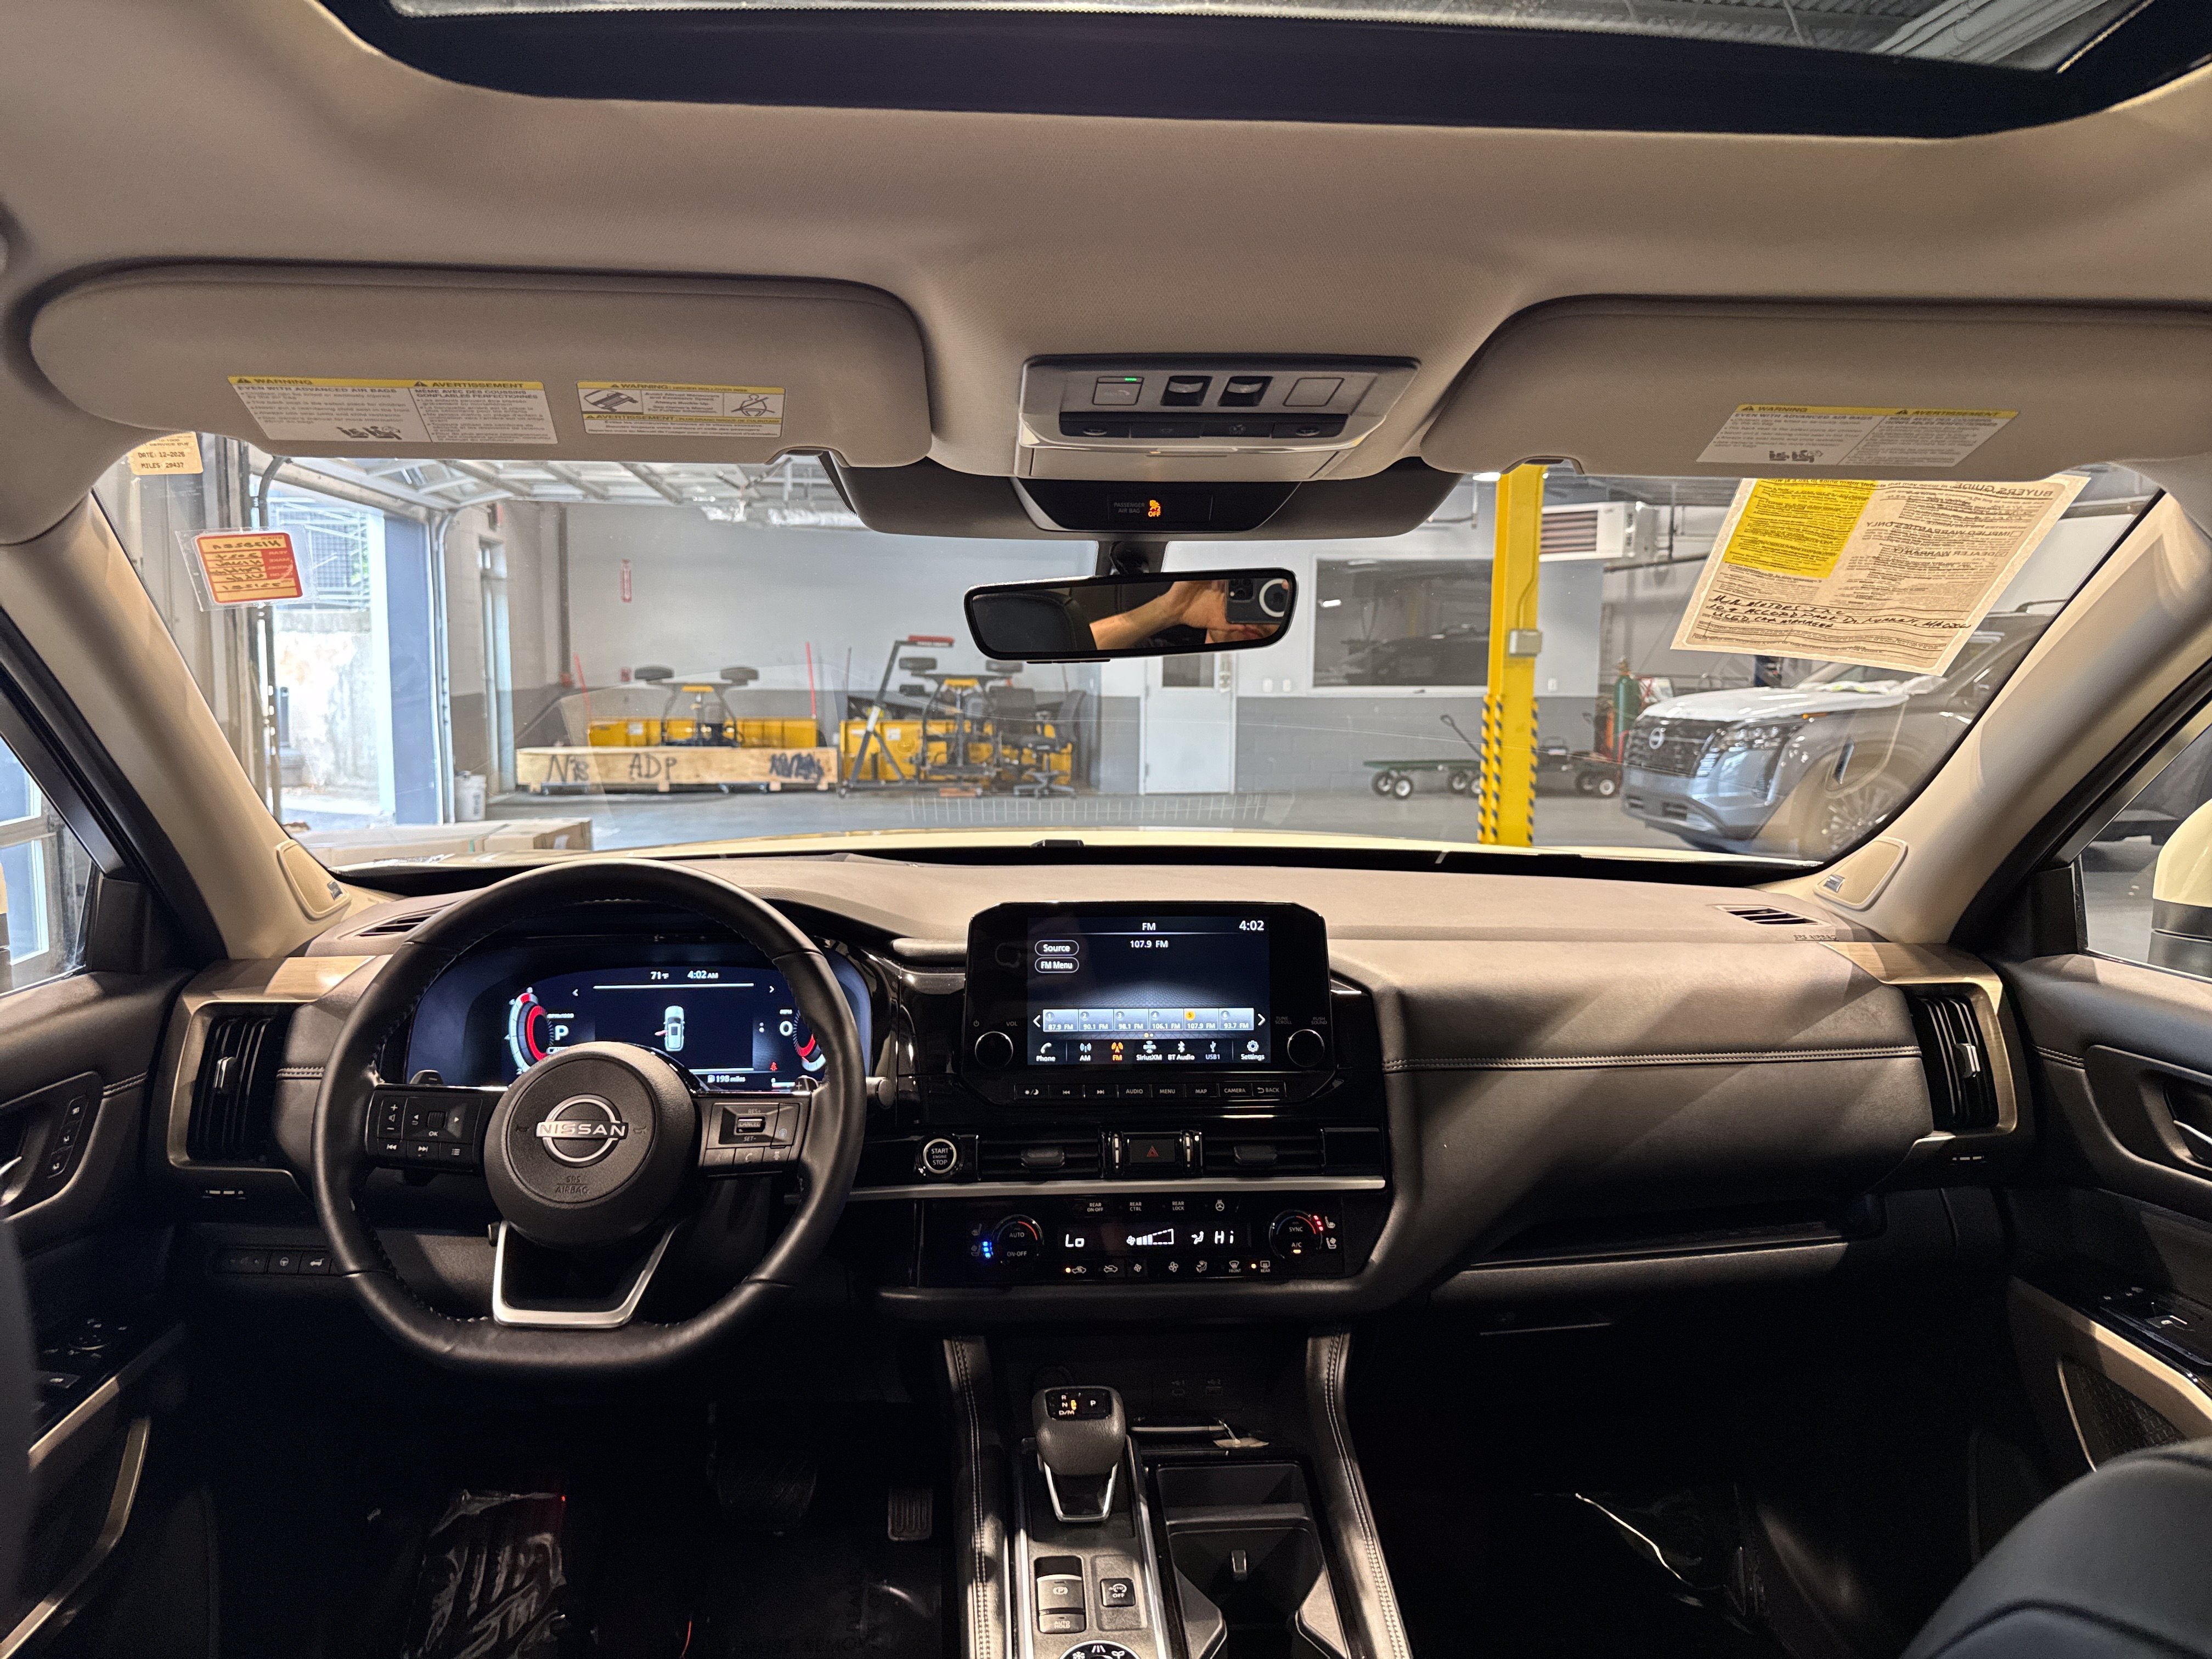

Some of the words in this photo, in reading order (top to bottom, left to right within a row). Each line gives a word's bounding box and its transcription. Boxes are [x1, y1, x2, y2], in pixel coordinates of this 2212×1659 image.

[1142, 922, 1156, 930] FM
[1239, 920, 1265, 931] 4:02
[1043, 944, 1070, 952] Source
[1130, 940, 1152, 949] 107.9
[1053, 961, 1073, 969] Menu
[687, 970, 707, 979] 4:02
[555, 1025, 569, 1041] P
[716, 1075, 729, 1083] 198
[539, 1123, 625, 1136] NISSAN
[555, 1185, 589, 1194] AIRBAG
[1065, 1233, 1085, 1248] Lo
[1214, 1230, 1234, 1244] Hi
